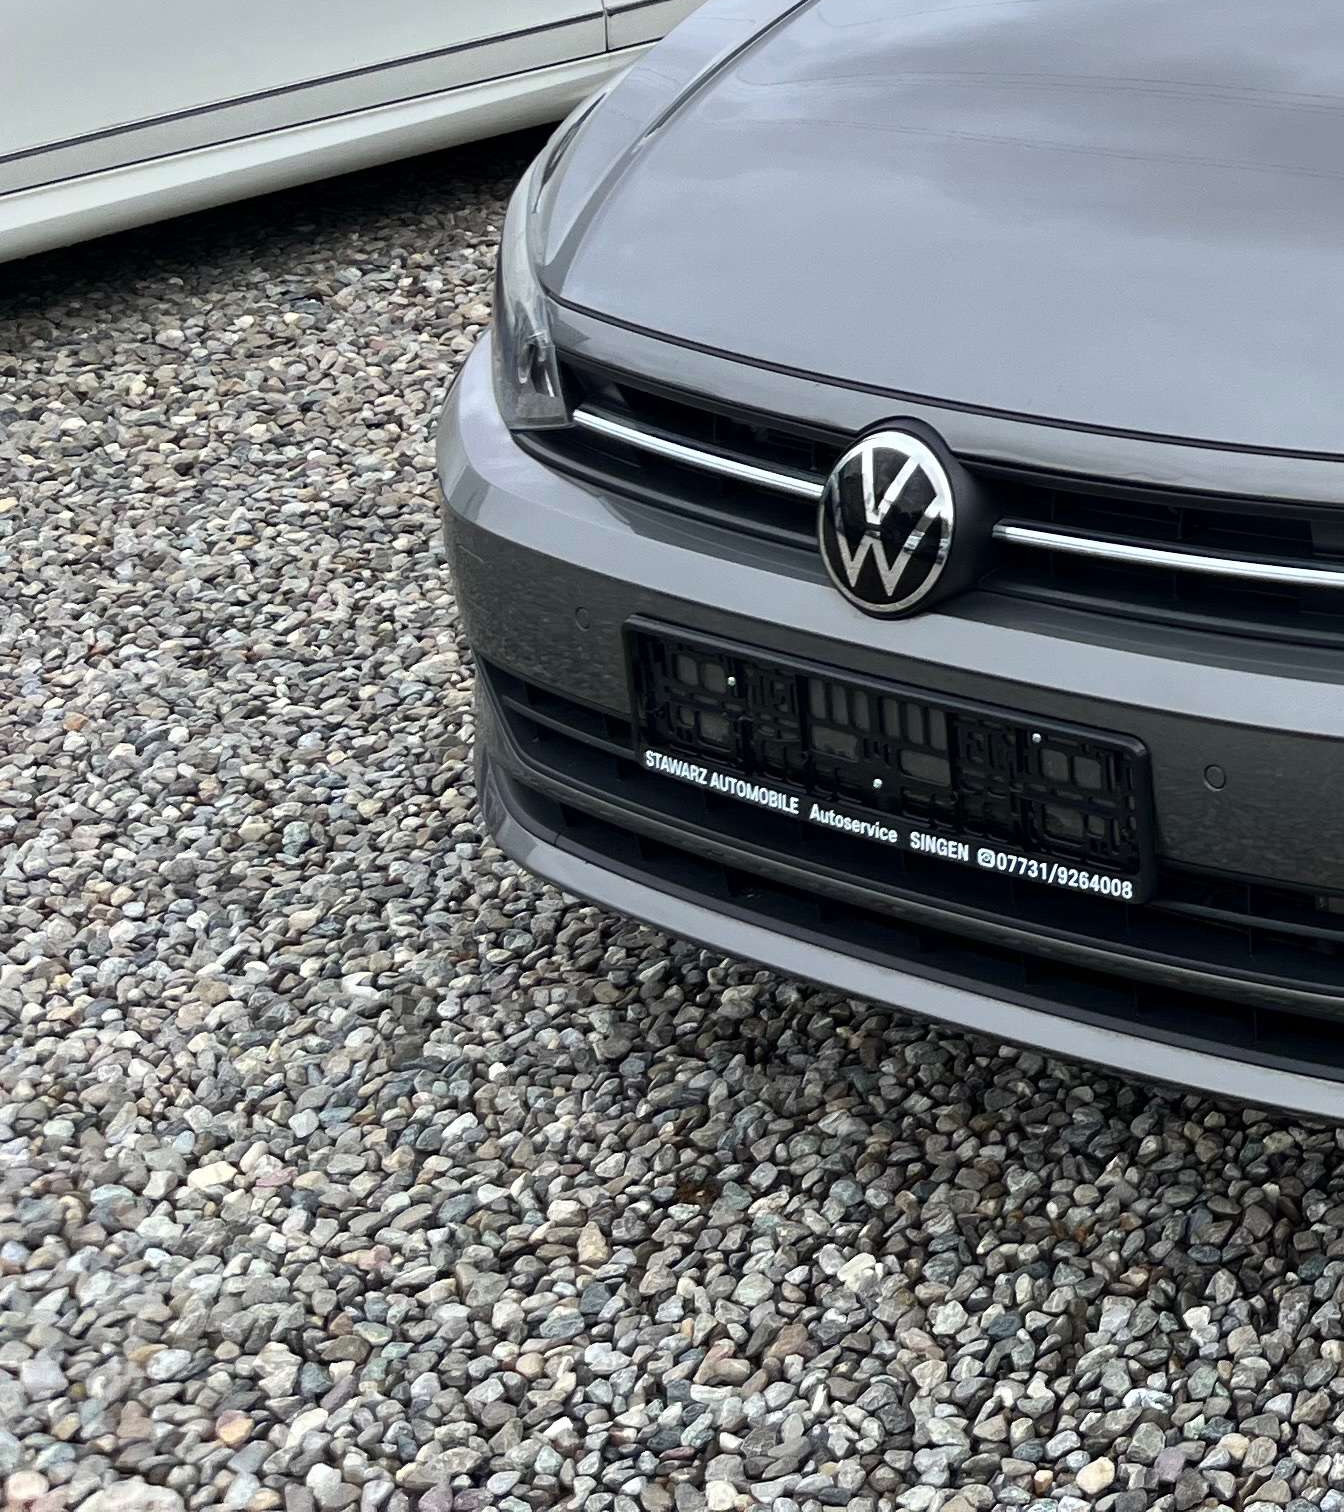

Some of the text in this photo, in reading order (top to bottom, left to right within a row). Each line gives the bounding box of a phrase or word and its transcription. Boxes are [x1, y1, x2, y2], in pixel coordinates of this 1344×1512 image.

[644, 749, 1134, 900] STAWARZ AUTOMOBILE Autoservice SINGEN 07731/9264008
